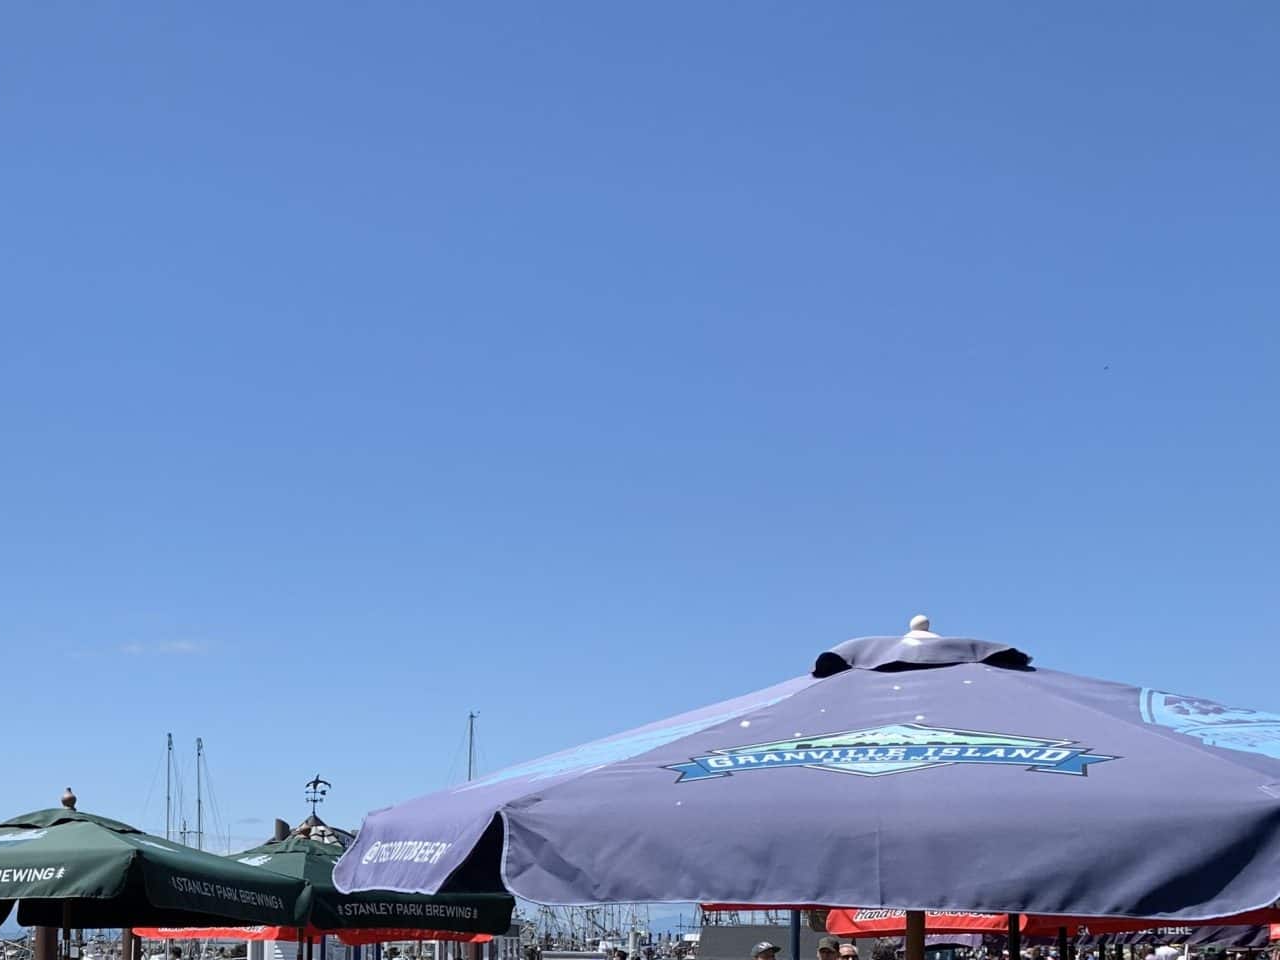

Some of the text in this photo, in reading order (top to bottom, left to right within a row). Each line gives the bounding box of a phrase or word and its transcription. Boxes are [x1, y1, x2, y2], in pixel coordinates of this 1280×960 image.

[706, 747, 1070, 769] GRANVILLE ISLAND
[176, 877, 280, 910] STANLEY PARK BREWING
[344, 903, 473, 919] STANLEY PARK BREWING
